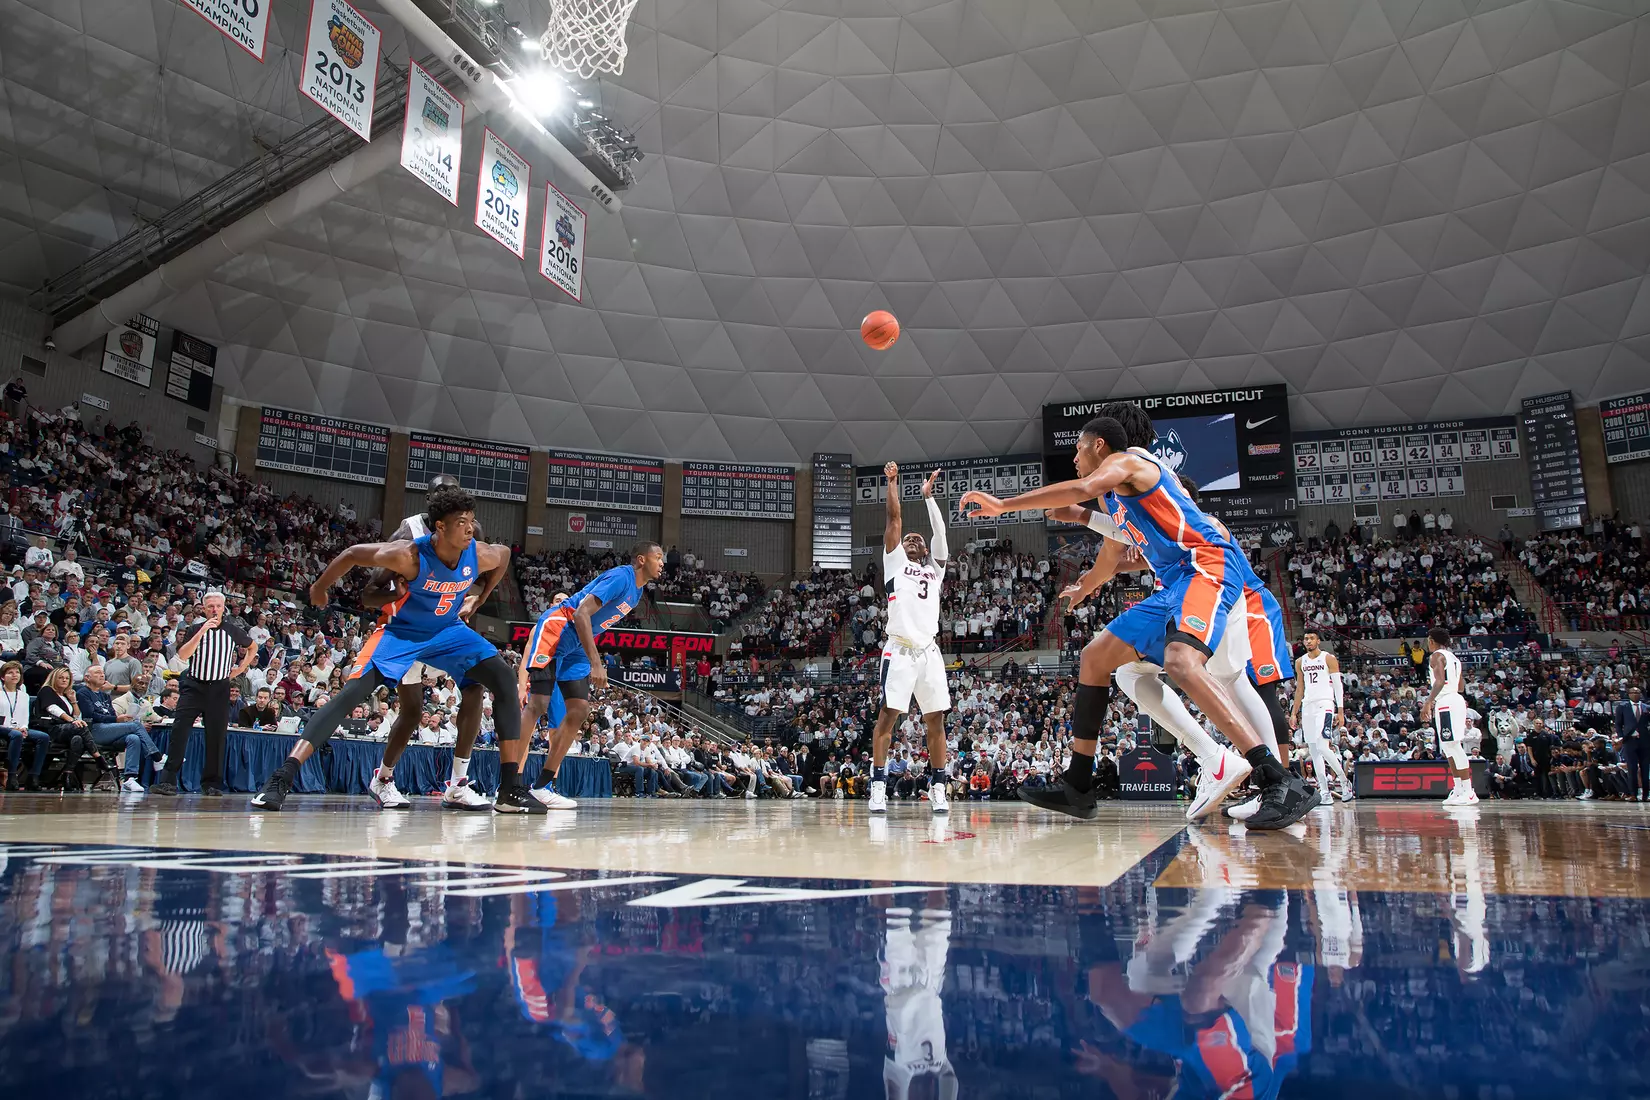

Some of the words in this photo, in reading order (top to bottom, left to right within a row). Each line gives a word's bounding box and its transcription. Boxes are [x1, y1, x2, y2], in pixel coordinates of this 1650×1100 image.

[190, 0, 255, 49] HAMPIONS
[331, 2, 366, 37] Basketball
[330, 25, 364, 60] FOUR
[341, 24, 364, 49] FINAL
[315, 50, 366, 103] 2013
[315, 75, 361, 117] NATIONAL
[310, 86, 363, 132] CHAMPIONS
[411, 127, 453, 173] 2014
[413, 149, 450, 184] NATIONAL
[408, 160, 452, 198] CHAMPIONS
[484, 188, 519, 228] 2015
[485, 210, 517, 240] NATIONAL
[481, 219, 519, 252] CHAMPIONS
[547, 239, 578, 275] 2016
[548, 258, 576, 285] NATIONAL
[545, 267, 577, 296] CHAMPIONS
[97, 399, 110, 410] 211
[1063, 399, 1141, 416] UNIVEY
[1145, 398, 1162, 409] OF
[1166, 390, 1263, 407] CONNECTICUT
[1535, 393, 1570, 404] HUSKIES
[1609, 396, 1643, 408] NCAA
[1530, 408, 1544, 416] STAT
[1545, 404, 1566, 413] BOARD
[264, 409, 282, 418] BIG
[288, 413, 316, 423] EAST
[320, 418, 387, 435] CONFERENCE
[1626, 412, 1645, 424] 2002
[263, 417, 302, 428] REGULAR
[305, 423, 337, 434] SEASON
[340, 429, 387, 442] CHAMPIONS
[1433, 421, 1464, 429] HONOR
[1629, 425, 1647, 437] 2011
[300, 430, 314, 441] 1995
[372, 442, 387, 452] 2002
[443, 438, 470, 447] AMERICAN
[470, 442, 495, 450] ATHLETIC
[495, 445, 528, 454] CONFERENCE
[1498, 441, 1512, 453] 50
[421, 442, 473, 453] TOURNAMENT
[475, 449, 519, 459] CHAMPIONS
[1381, 449, 1399, 461] 13
[1409, 447, 1429, 459] 42
[1440, 445, 1453, 457] 34
[1470, 443, 1482, 455] 32
[554, 452, 583, 460] NATIONAL
[585, 455, 618, 463] INVITATION
[620, 458, 659, 466] TOURNAMENT
[1298, 455, 1317, 468] 52
[1352, 451, 1371, 463] 00
[259, 460, 310, 472] CONNECTICUT
[337, 472, 382, 483] BASKETBALL
[513, 461, 527, 470] 2011
[580, 461, 633, 470] APPEARANCES
[689, 463, 715, 471] NCAA
[719, 464, 789, 474] CHAMPIONSHIP
[567, 467, 580, 476] 1974
[584, 468, 596, 477] 1975
[688, 470, 736, 478] TOURNAMENT
[1248, 474, 1279, 482] TRAVELERS
[952, 481, 968, 492] 42
[974, 479, 991, 490] 44
[1023, 475, 1040, 487] 42
[1416, 480, 1429, 492] 13
[1447, 478, 1454, 490] 3
[904, 484, 921, 496] 22
[1305, 487, 1315, 499] 15
[1331, 486, 1343, 497] 22
[1387, 482, 1400, 494] 42
[481, 491, 524, 500] BASKETBALL
[549, 498, 594, 506] CONNECTICUT
[618, 503, 659, 512] BASKETBALL
[952, 510, 968, 522] 24
[1543, 508, 1558, 517] TIME
[1558, 507, 1567, 515] OF
[1567, 506, 1580, 514] DAY
[603, 515, 622, 523] 1988
[1554, 514, 1581, 528] 3:44
[422, 577, 474, 594] FLORIDA
[917, 580, 928, 600] 3
[434, 593, 457, 616] 5
[651, 635, 667, 649] &
[671, 636, 714, 652] SON
[1393, 657, 1409, 665] 116
[1473, 655, 1488, 663] 117
[1302, 664, 1325, 672] UCONN
[623, 671, 666, 684] UCONN
[1308, 672, 1318, 684] 12
[1120, 783, 1171, 792] TRAVELERS
